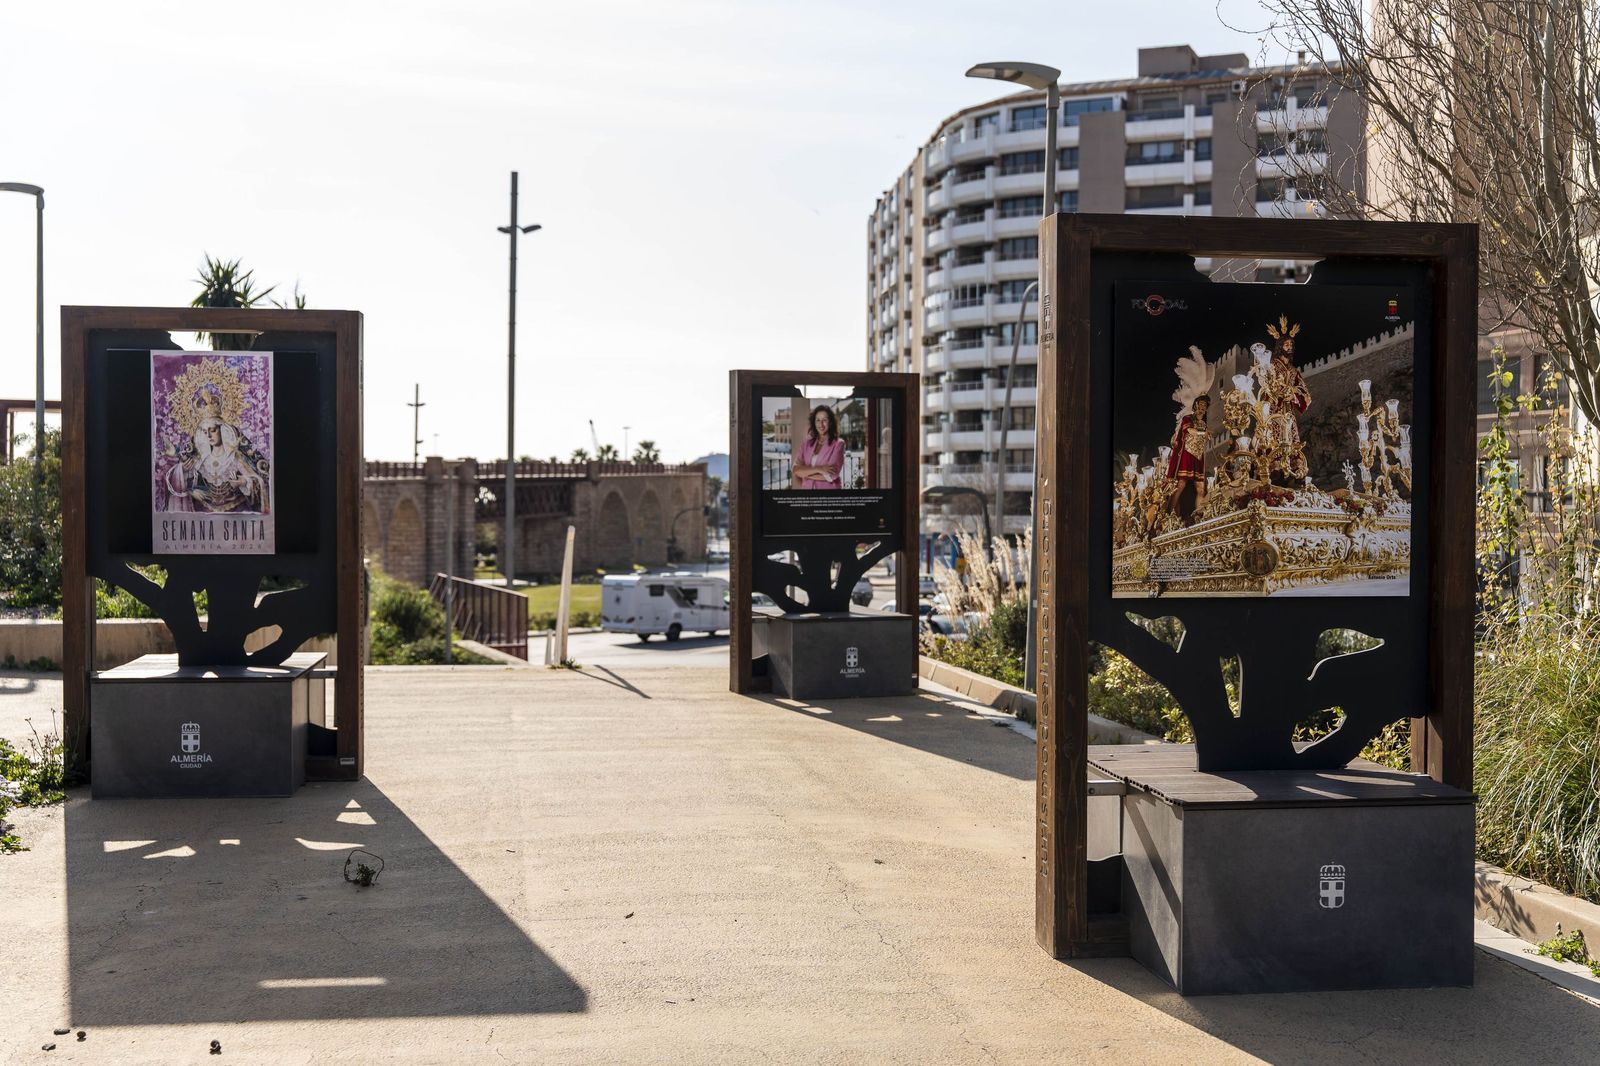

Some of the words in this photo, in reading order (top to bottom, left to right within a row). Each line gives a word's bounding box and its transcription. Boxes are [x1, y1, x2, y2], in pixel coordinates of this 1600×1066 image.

[162, 519, 215, 541] SEMANA
[223, 519, 265, 541] SANTA
[1040, 498, 1052, 878] turismodealmeria.org
[170, 752, 213, 763] ALMERÍA
